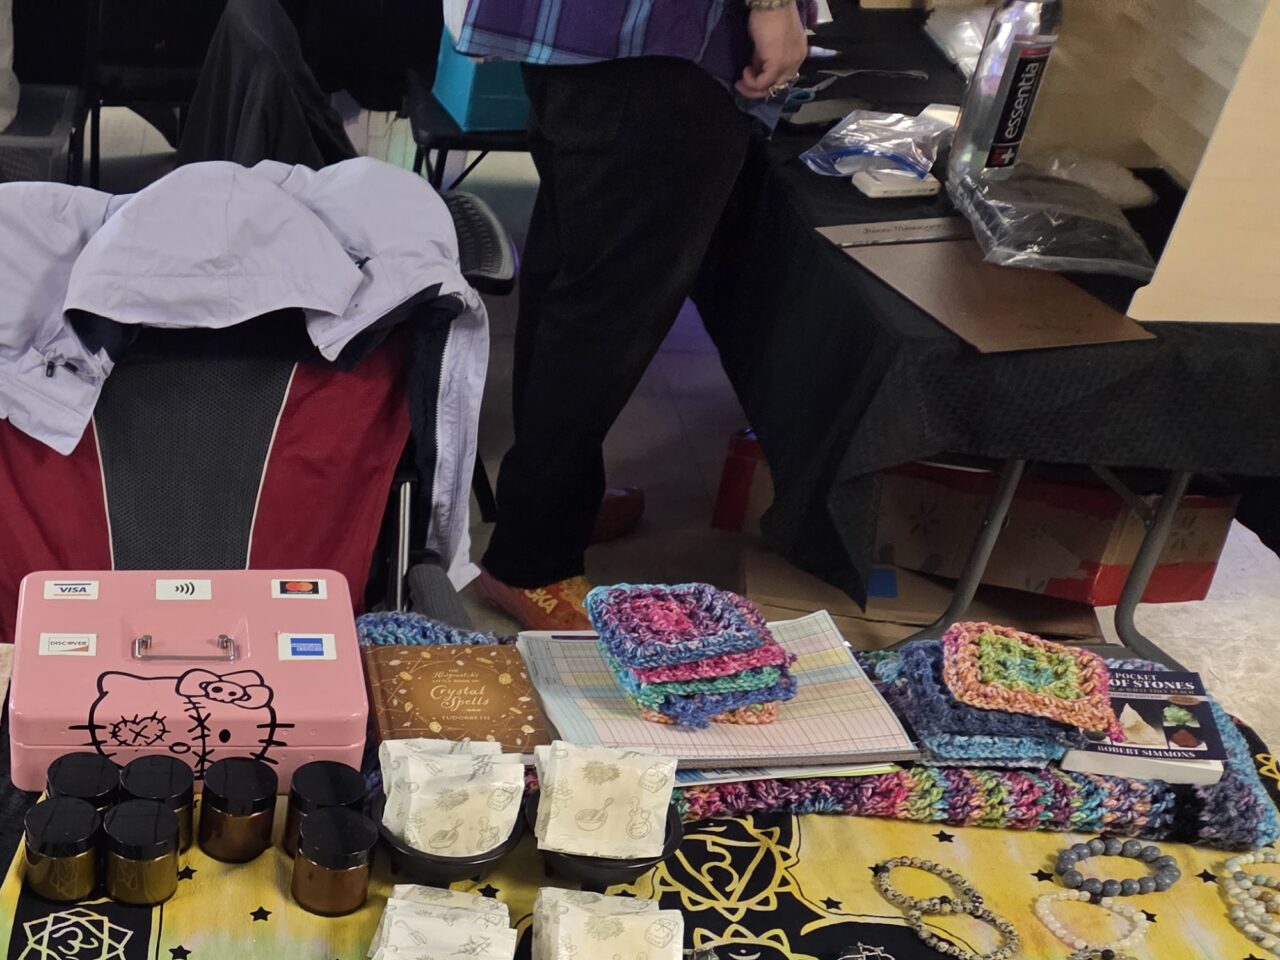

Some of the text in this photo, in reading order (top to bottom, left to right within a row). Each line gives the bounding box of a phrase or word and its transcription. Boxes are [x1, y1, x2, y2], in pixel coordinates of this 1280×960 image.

[1005, 62, 1039, 139] essentia
[1115, 672, 1157, 680] POCKET
[1109, 679, 1195, 690] OF STONES
[430, 684, 486, 701] Crystal
[440, 695, 489, 712] Spells
[1098, 745, 1196, 758] ROBERT SIMMONS
